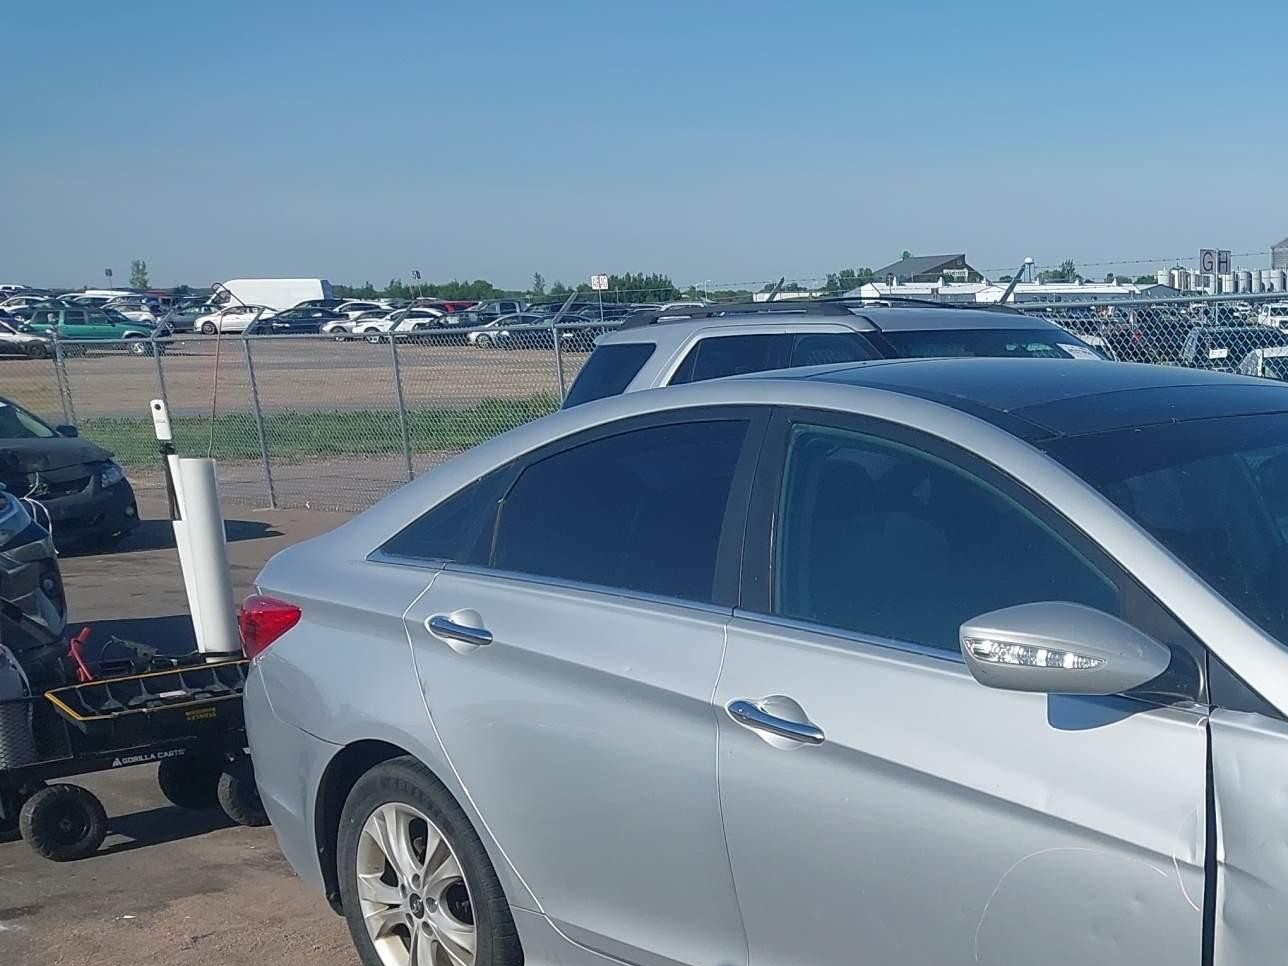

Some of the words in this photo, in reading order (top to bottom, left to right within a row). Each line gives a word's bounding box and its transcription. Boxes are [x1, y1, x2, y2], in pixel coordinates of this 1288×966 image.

[1202, 250, 1213, 272] G
[1217, 251, 1228, 273] H
[122, 753, 156, 764] GORILLA
[157, 749, 185, 759] CARTS
